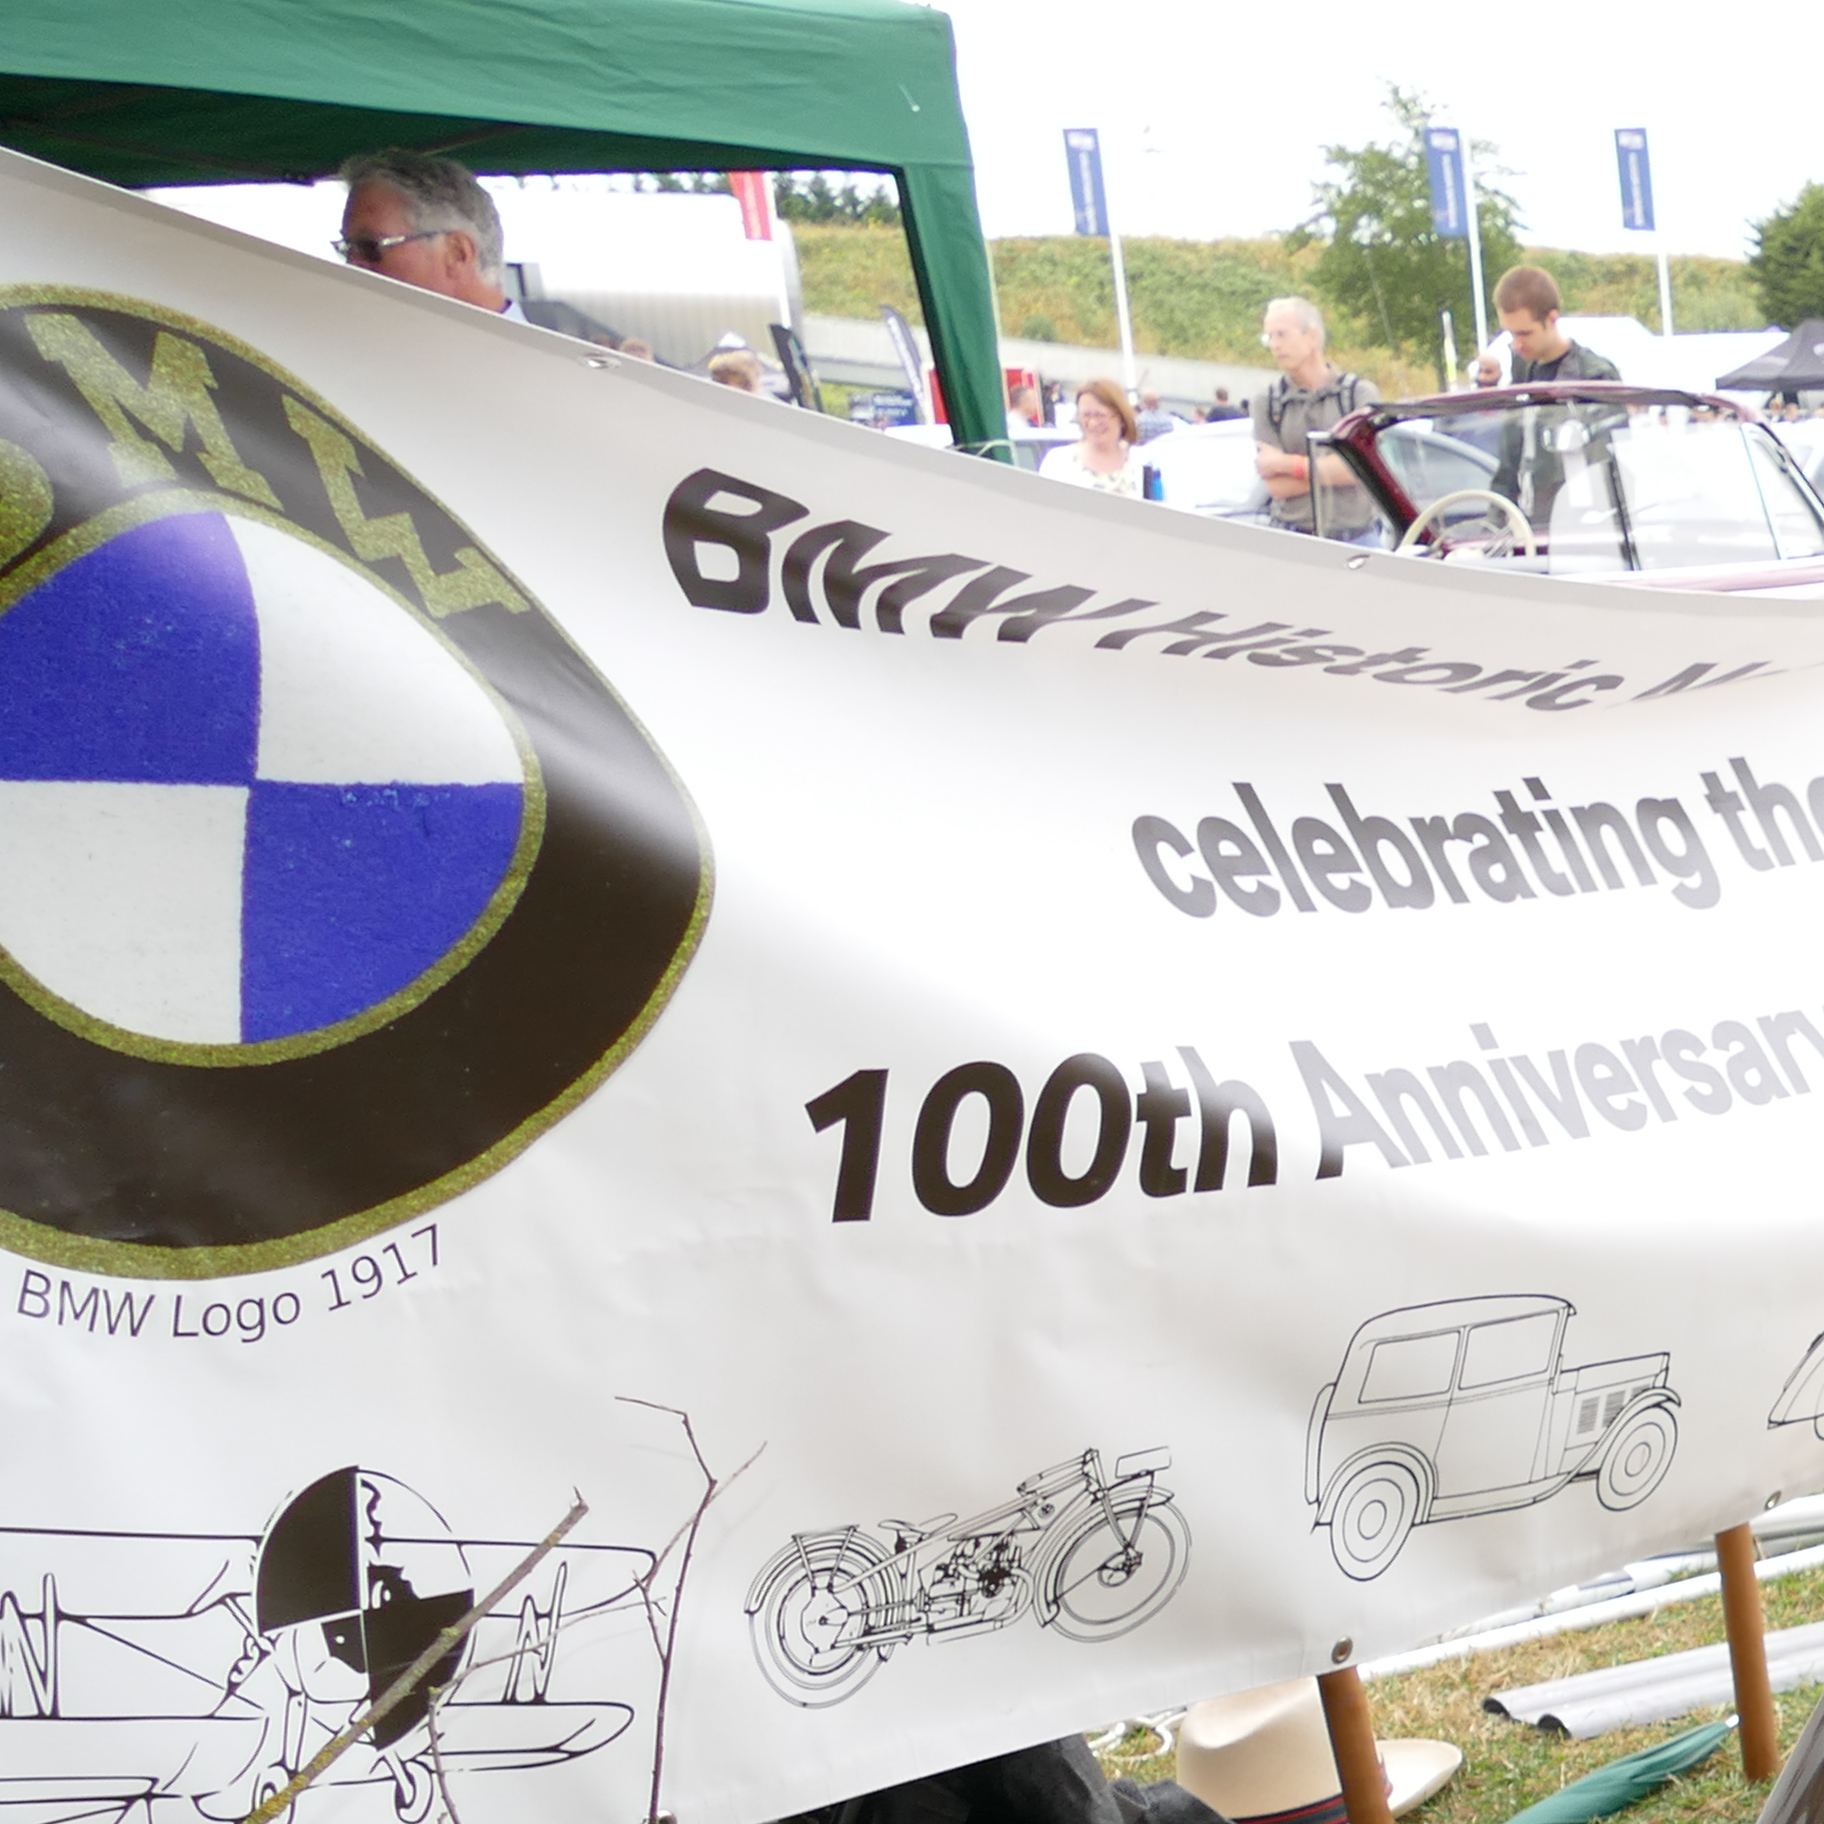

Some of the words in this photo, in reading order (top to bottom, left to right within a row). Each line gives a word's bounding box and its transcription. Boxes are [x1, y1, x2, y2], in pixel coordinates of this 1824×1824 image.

[662, 467, 1160, 652] BMW
[1161, 608, 1626, 712] Historic
[1131, 777, 1722, 919] celebrating
[805, 1046, 1277, 1224] 100th
[16, 1270, 155, 1338] BMW
[171, 1289, 302, 1344] Logo
[321, 1223, 442, 1313] 1917
